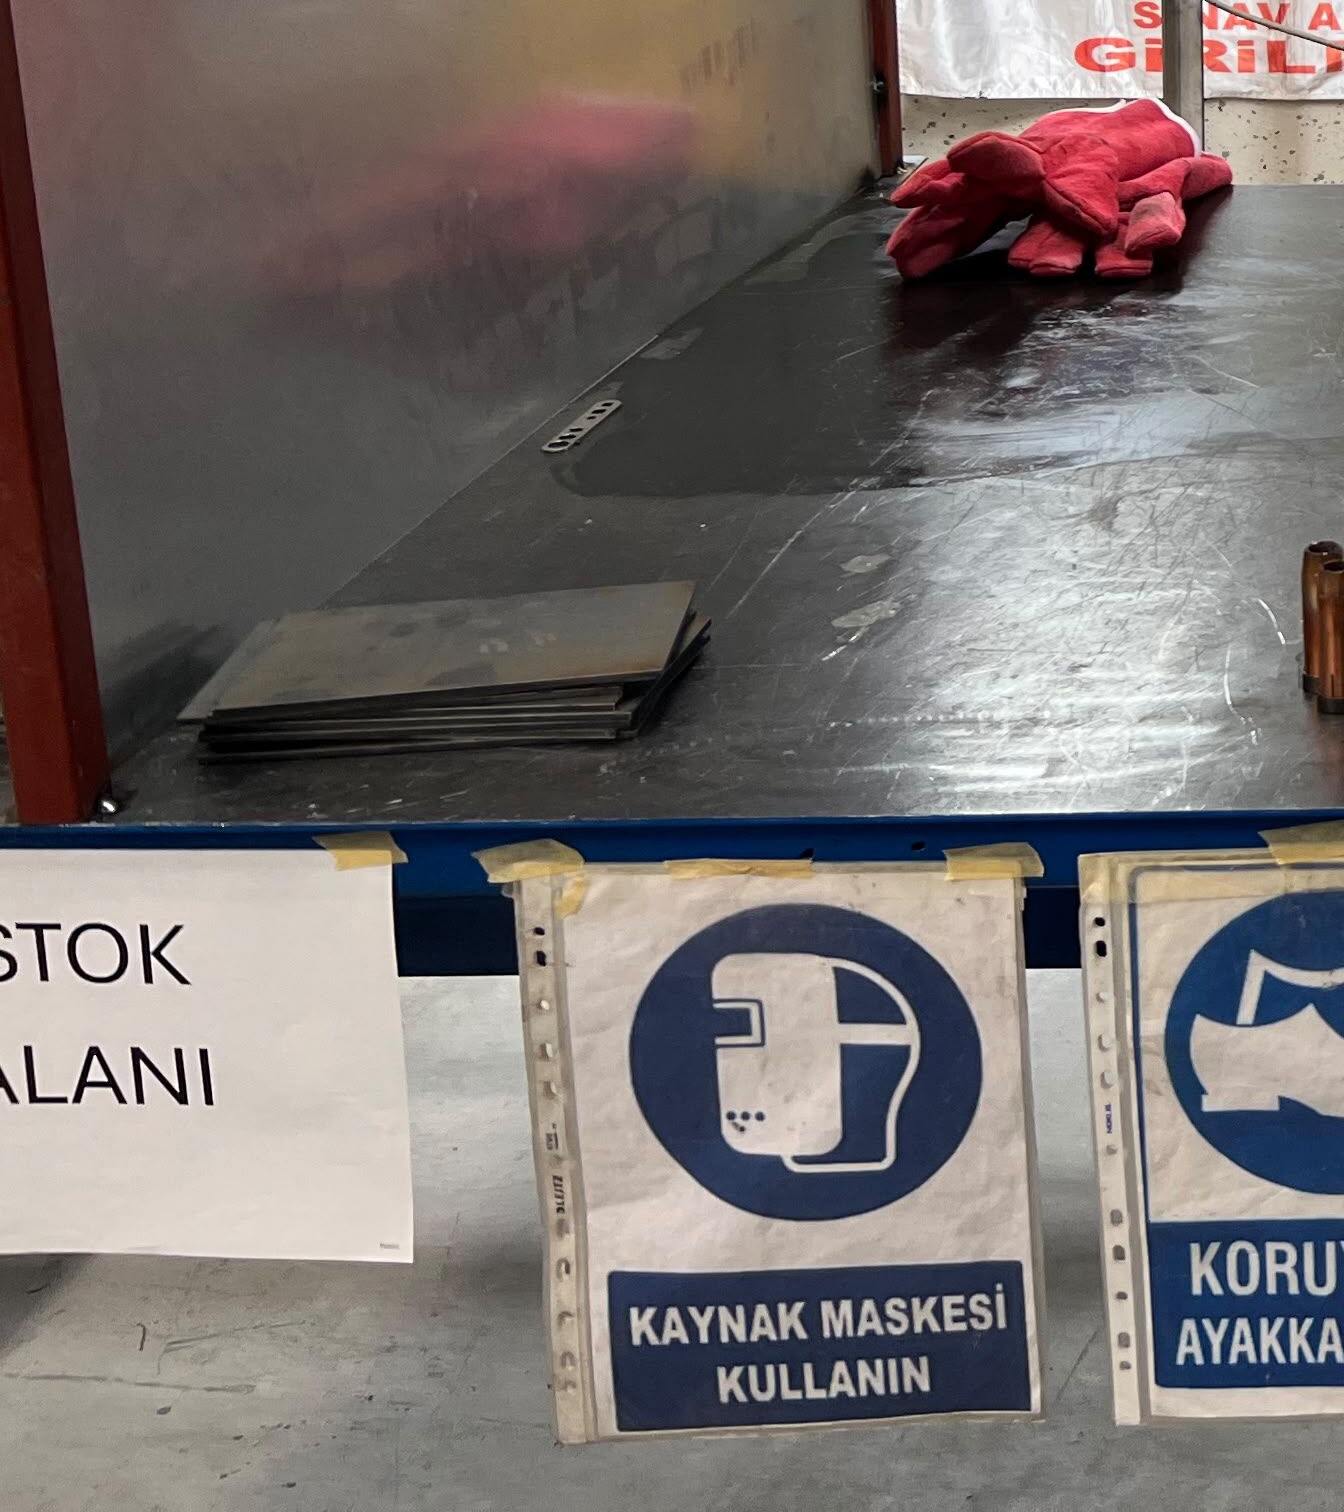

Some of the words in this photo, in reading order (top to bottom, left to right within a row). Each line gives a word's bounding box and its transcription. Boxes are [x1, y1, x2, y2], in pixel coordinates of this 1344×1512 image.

[1133, 1, 1290, 31] SNAV
[628, 1301, 808, 1347] KAYNAK
[821, 1284, 1008, 1340] MASKESİ
[715, 1355, 932, 1405] KULLANIN
